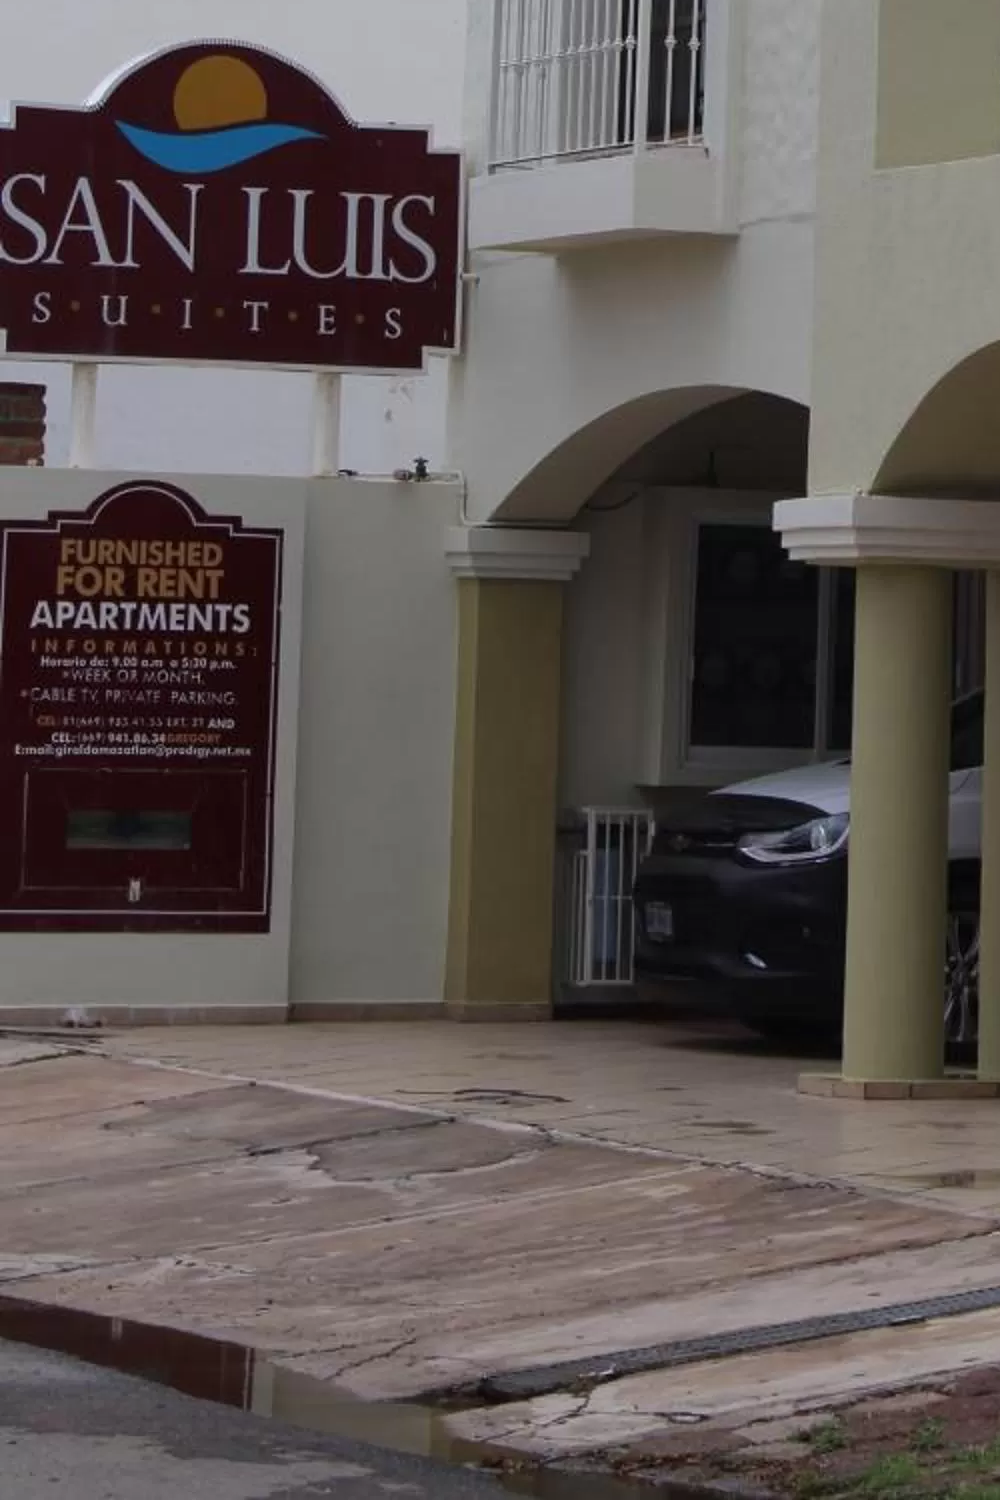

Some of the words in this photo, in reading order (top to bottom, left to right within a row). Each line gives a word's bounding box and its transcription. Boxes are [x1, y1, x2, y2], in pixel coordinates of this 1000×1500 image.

[0, 173, 204, 274] SAN
[238, 187, 437, 284] LUIS
[61, 538, 223, 566] FURNISHED
[56, 566, 125, 597] FOR
[138, 568, 225, 599] RENT
[30, 601, 251, 633] APARTMENTS
[40, 655, 86, 667] Horario
[117, 670, 138, 683] OR
[105, 688, 161, 705] PRIVATE
[207, 717, 235, 729] AND
